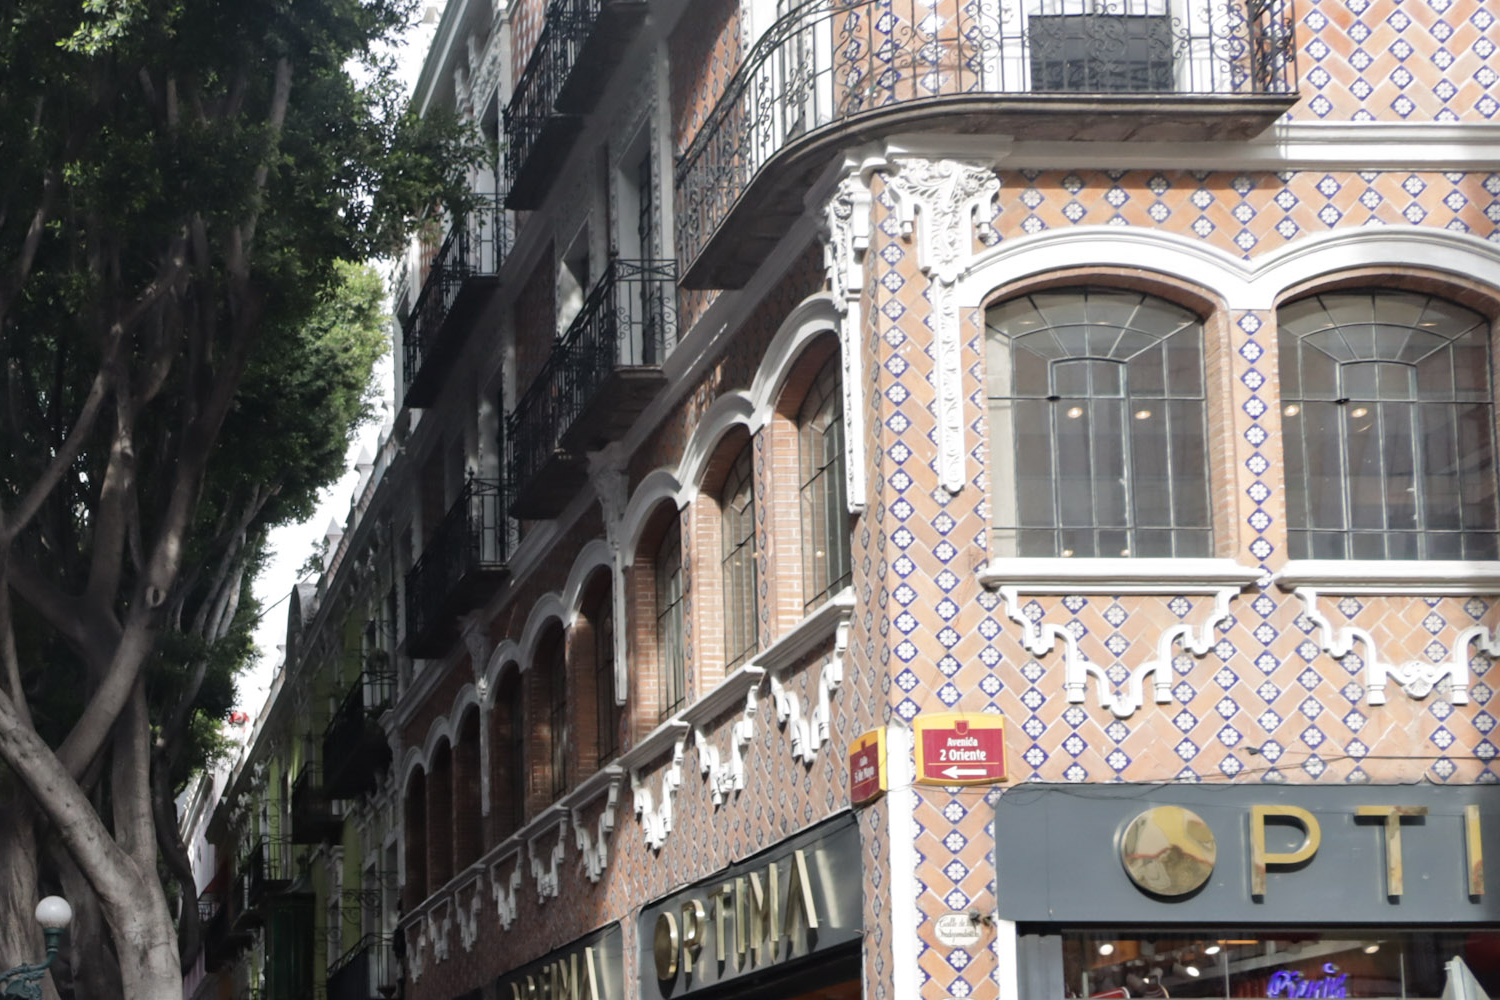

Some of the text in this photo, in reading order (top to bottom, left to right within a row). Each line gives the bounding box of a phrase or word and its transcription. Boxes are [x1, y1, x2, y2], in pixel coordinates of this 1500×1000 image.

[946, 738, 978, 747] Avenida
[939, 749, 987, 761] 2 Oriente
[654, 850, 818, 980] OPTIMA
